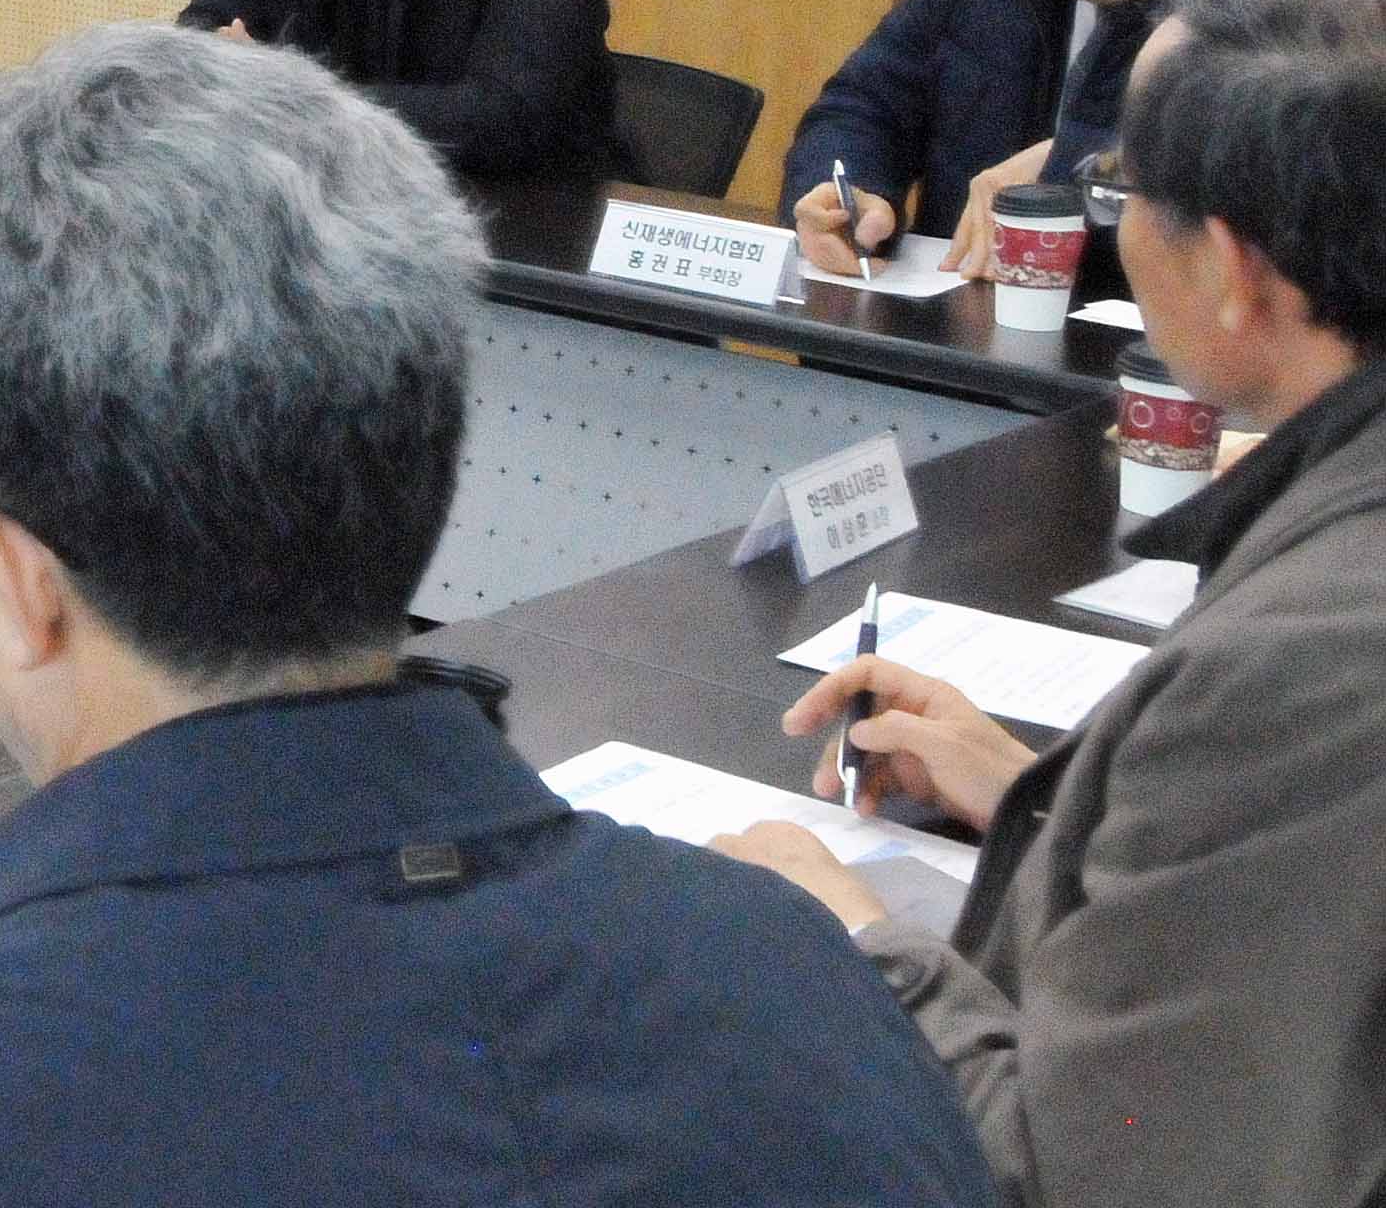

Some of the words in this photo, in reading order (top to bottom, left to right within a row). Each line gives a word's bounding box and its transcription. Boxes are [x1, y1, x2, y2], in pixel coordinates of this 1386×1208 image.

[621, 219, 765, 263] 신재생에너지협회
[696, 265, 743, 288] 부회장
[807, 463, 888, 517] 한국에너지공단
